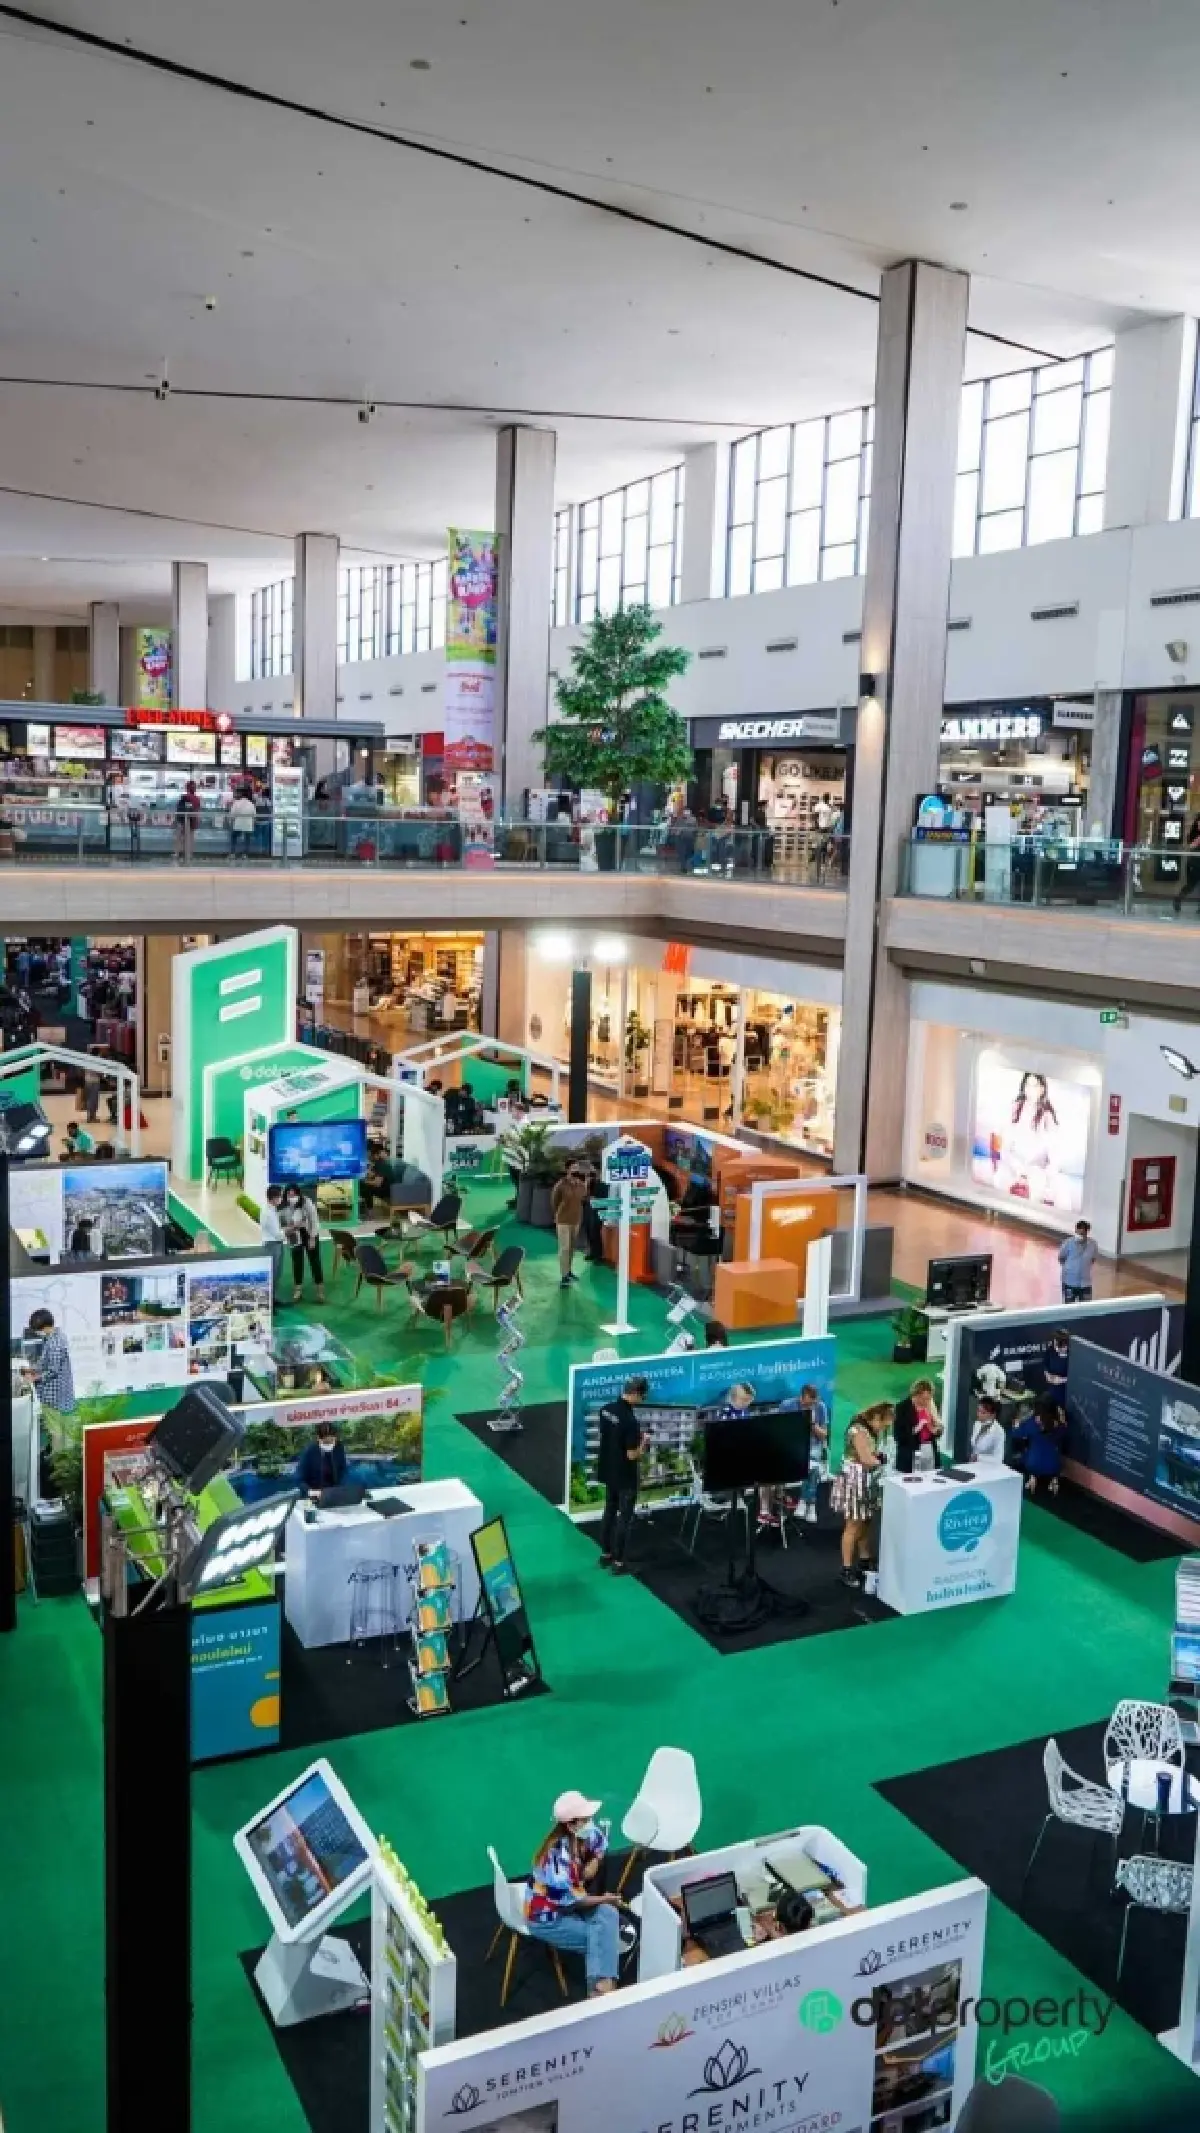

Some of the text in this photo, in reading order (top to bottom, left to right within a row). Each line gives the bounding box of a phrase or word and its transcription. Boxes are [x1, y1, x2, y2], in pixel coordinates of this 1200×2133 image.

[719, 720, 803, 740] SKECHER
[611, 1166, 648, 1180] SALE
[700, 1367, 754, 1382] RADISSON
[886, 1918, 972, 1957] SERENITY
[692, 1989, 747, 2022] ZENSIRI
[753, 1974, 801, 2000] VILLAS
[486, 2046, 595, 2092] SERENITY
